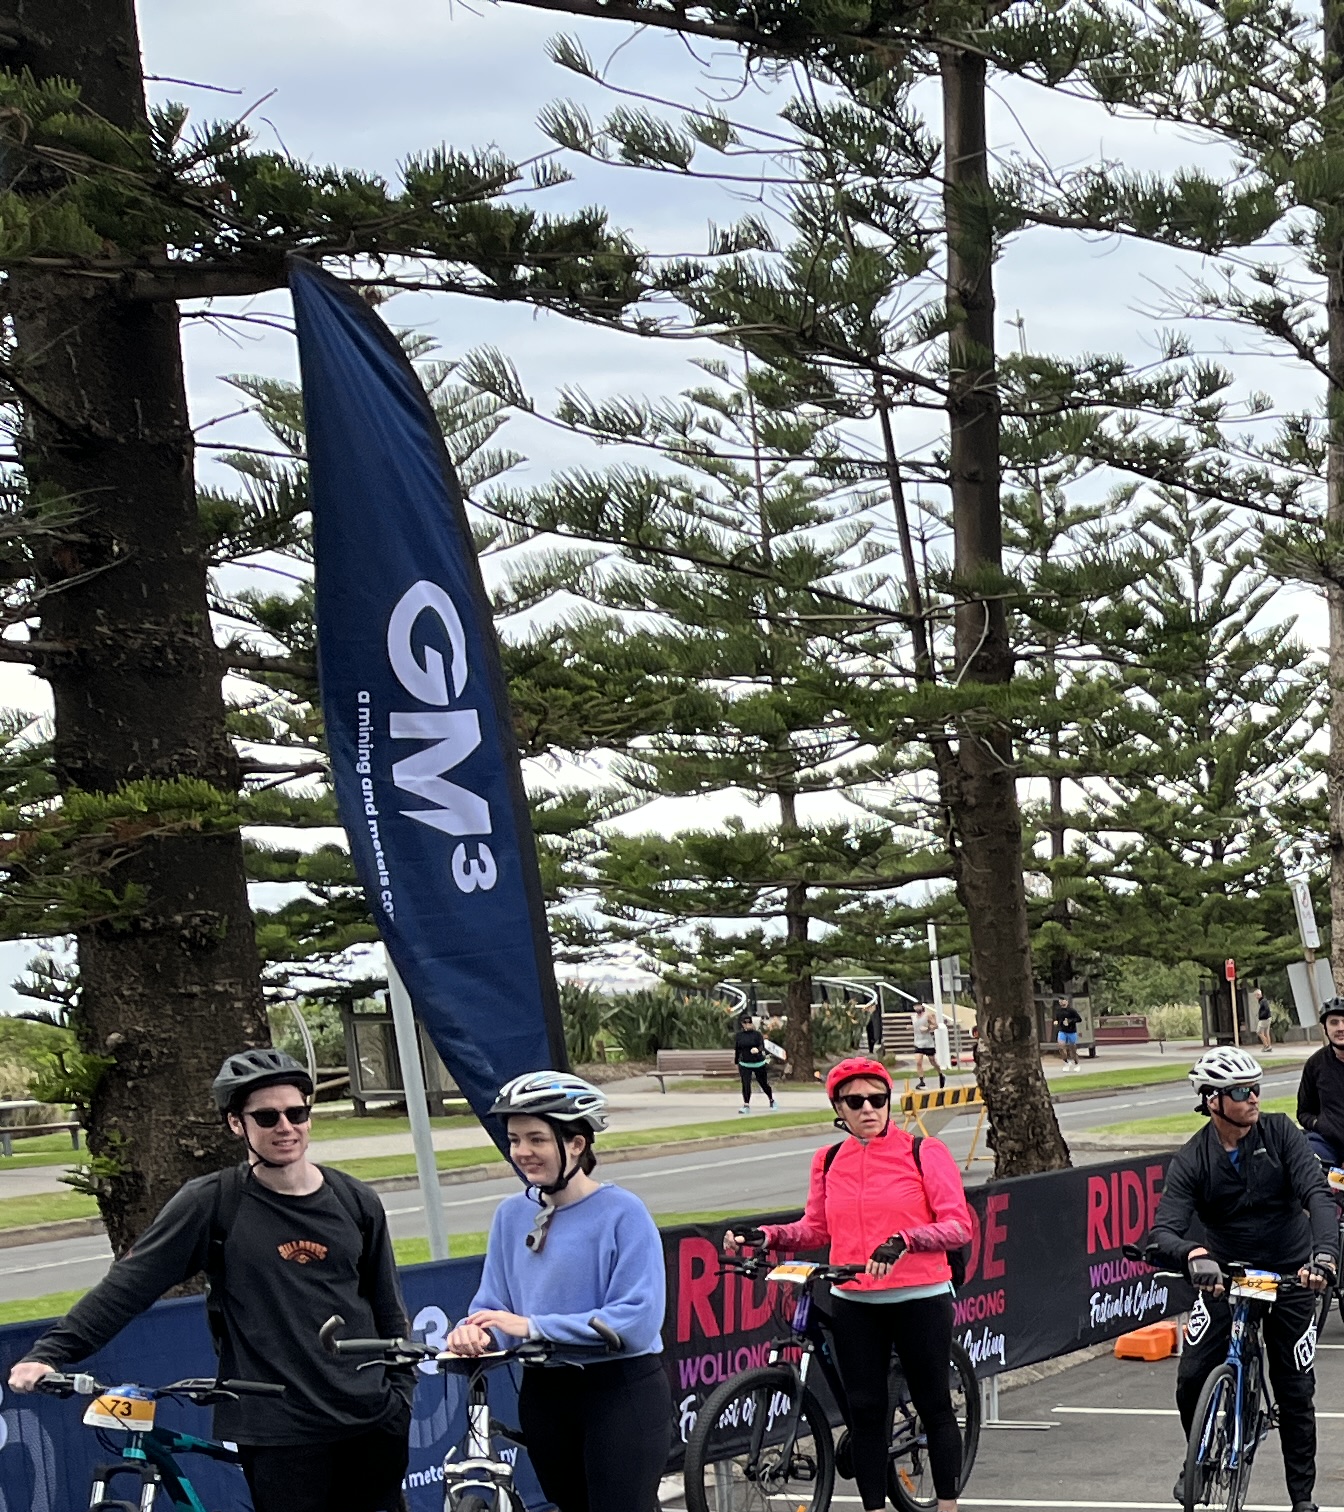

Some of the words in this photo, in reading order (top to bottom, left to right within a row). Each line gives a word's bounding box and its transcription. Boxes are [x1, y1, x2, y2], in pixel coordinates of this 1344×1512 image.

[357, 690, 370, 704] a
[356, 706, 374, 774] mining
[361, 777, 379, 816] and
[368, 819, 390, 887] metals
[1247, 1278, 1263, 1289] 62
[1089, 1286, 1124, 1329] Festival
[1133, 1279, 1169, 1322] Cycling
[111, 1399, 132, 1416] 73
